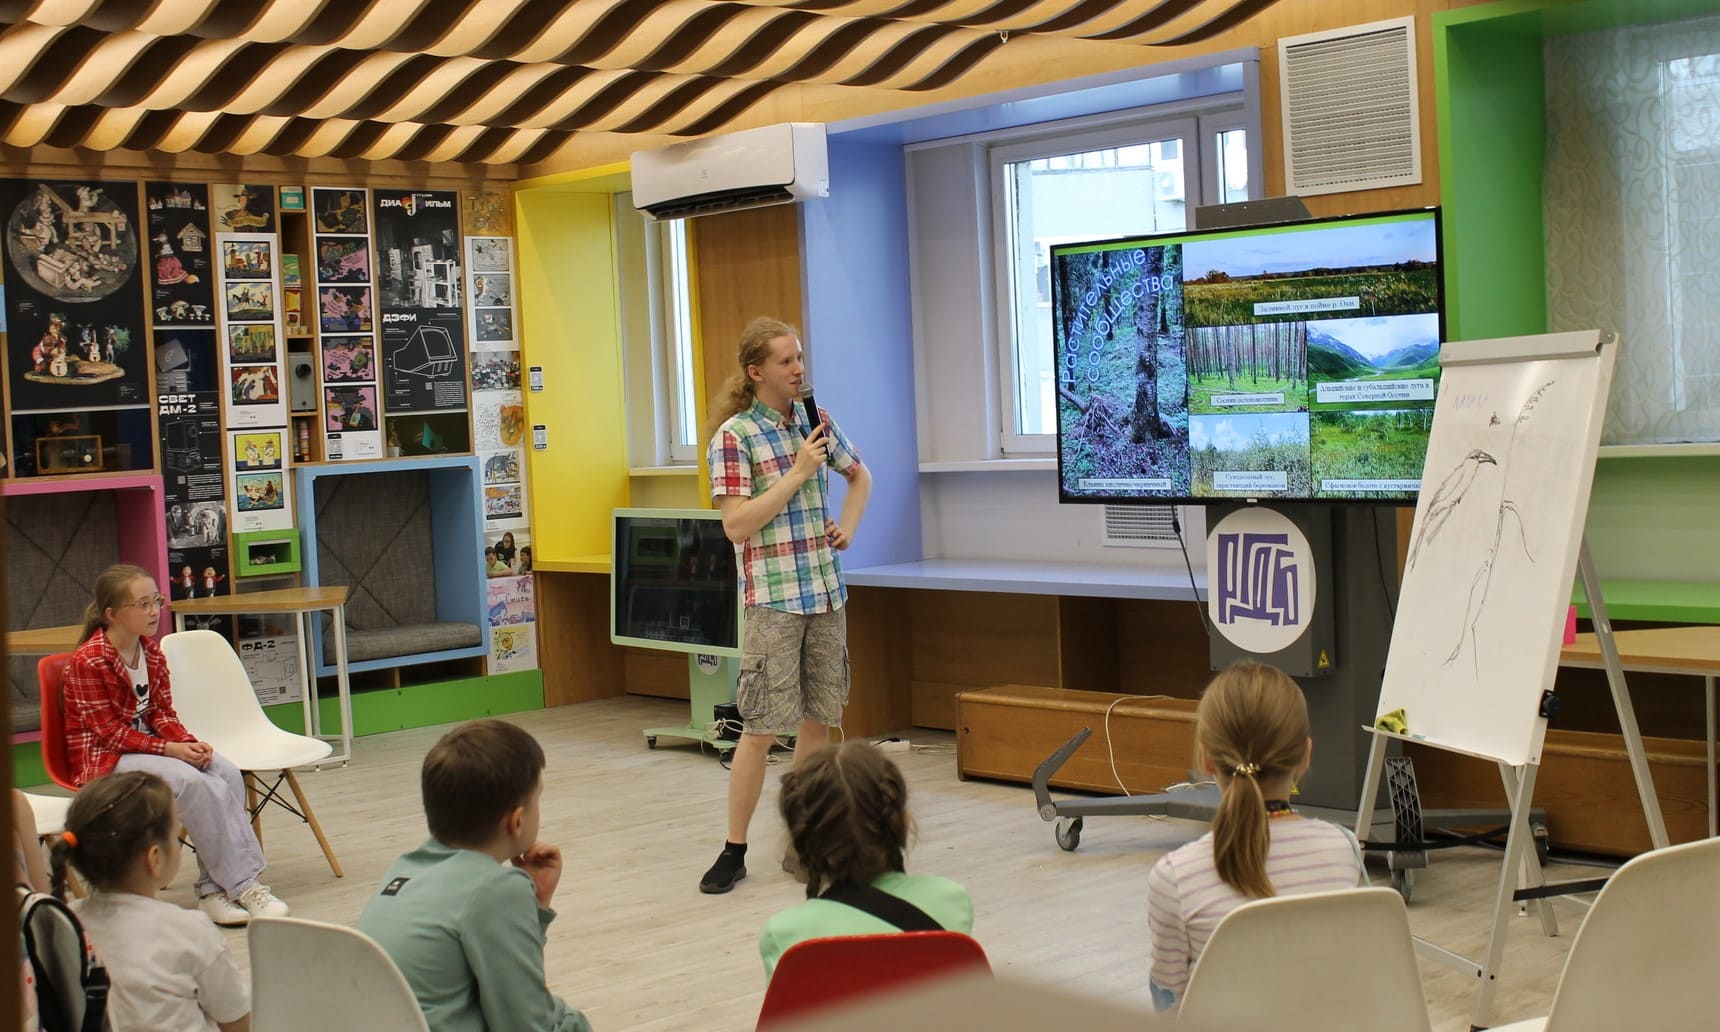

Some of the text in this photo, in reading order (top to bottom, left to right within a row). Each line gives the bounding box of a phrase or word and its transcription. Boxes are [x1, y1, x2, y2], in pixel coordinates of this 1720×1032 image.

[382, 313, 417, 323] ДЭФИ
[1062, 249, 1146, 383] Растительные
[1087, 275, 1174, 381] сообщества
[158, 394, 196, 404] СВЕТ
[242, 640, 275, 651] ФД-2
